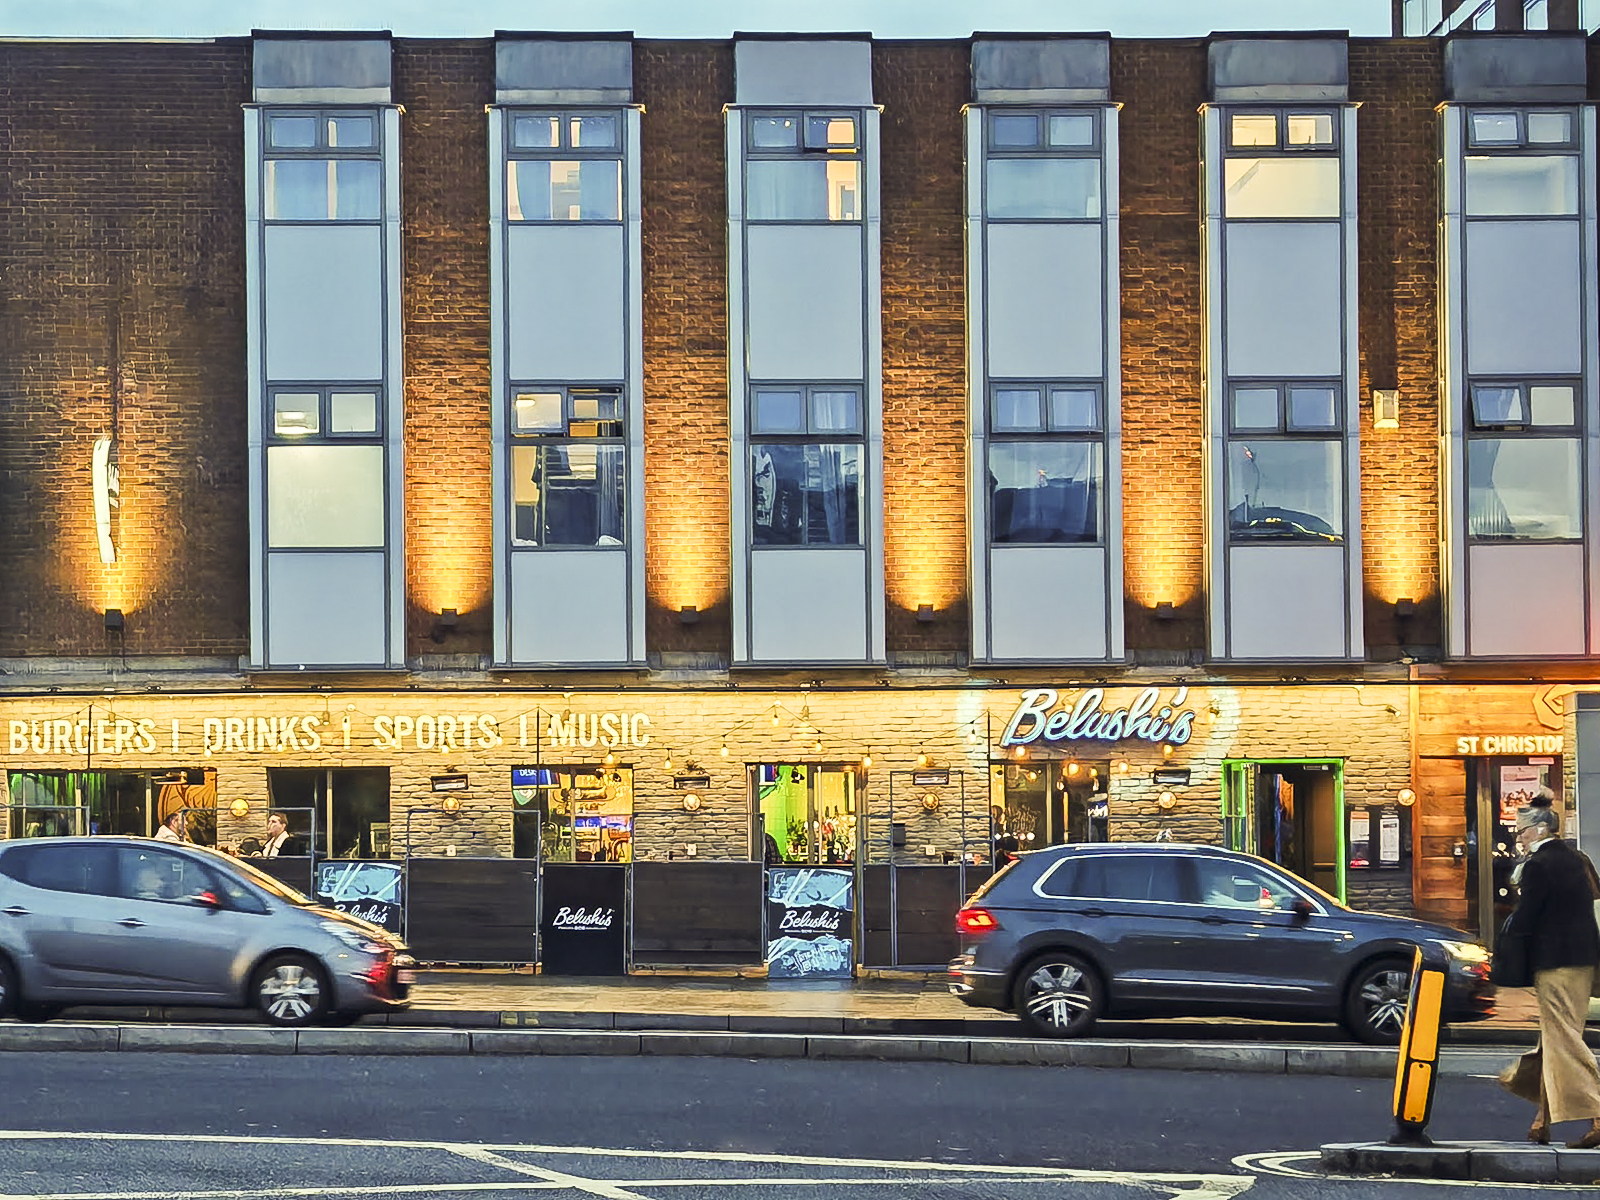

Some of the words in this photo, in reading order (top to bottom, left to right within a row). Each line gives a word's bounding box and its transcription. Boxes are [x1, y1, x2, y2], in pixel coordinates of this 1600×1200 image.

[999, 686, 1195, 748] Belushi's
[8, 718, 156, 755] BURGERS
[203, 716, 321, 752] DRINKS
[372, 713, 500, 750] SPORTS
[550, 712, 650, 748] MUSIC
[1457, 736, 1480, 754] ST
[552, 906, 613, 927] Belushi's
[779, 910, 840, 930] Belushi's
